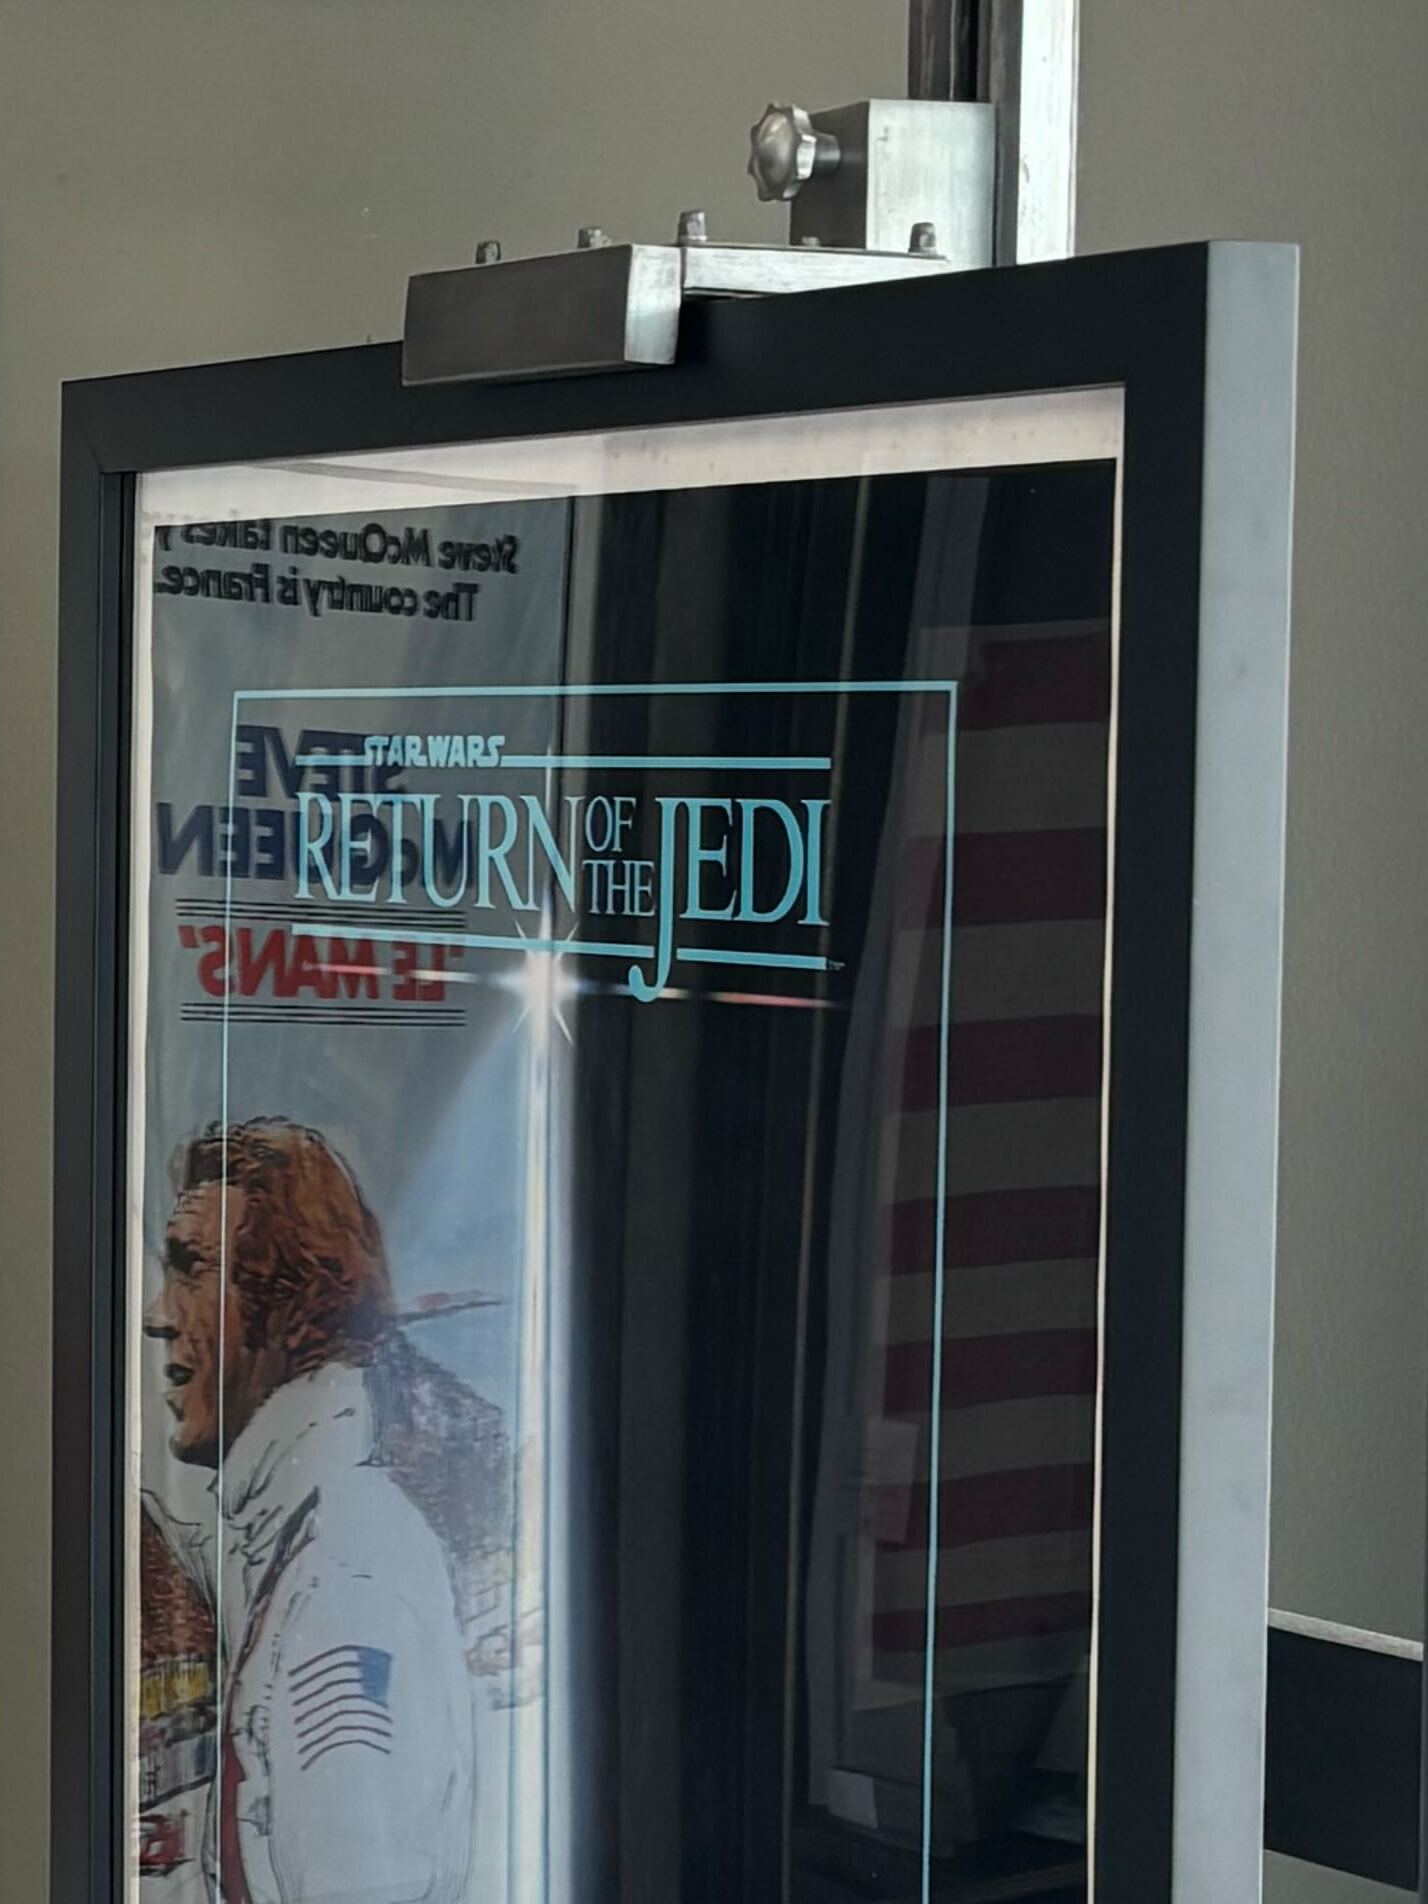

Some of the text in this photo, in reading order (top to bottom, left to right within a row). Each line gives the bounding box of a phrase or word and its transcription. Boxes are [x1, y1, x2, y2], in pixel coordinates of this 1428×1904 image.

[363, 734, 505, 767] STAR WARS
[294, 792, 583, 913] RETURN
[584, 796, 636, 853] OF
[583, 859, 655, 917] THE
[628, 796, 831, 1004] JEDI
